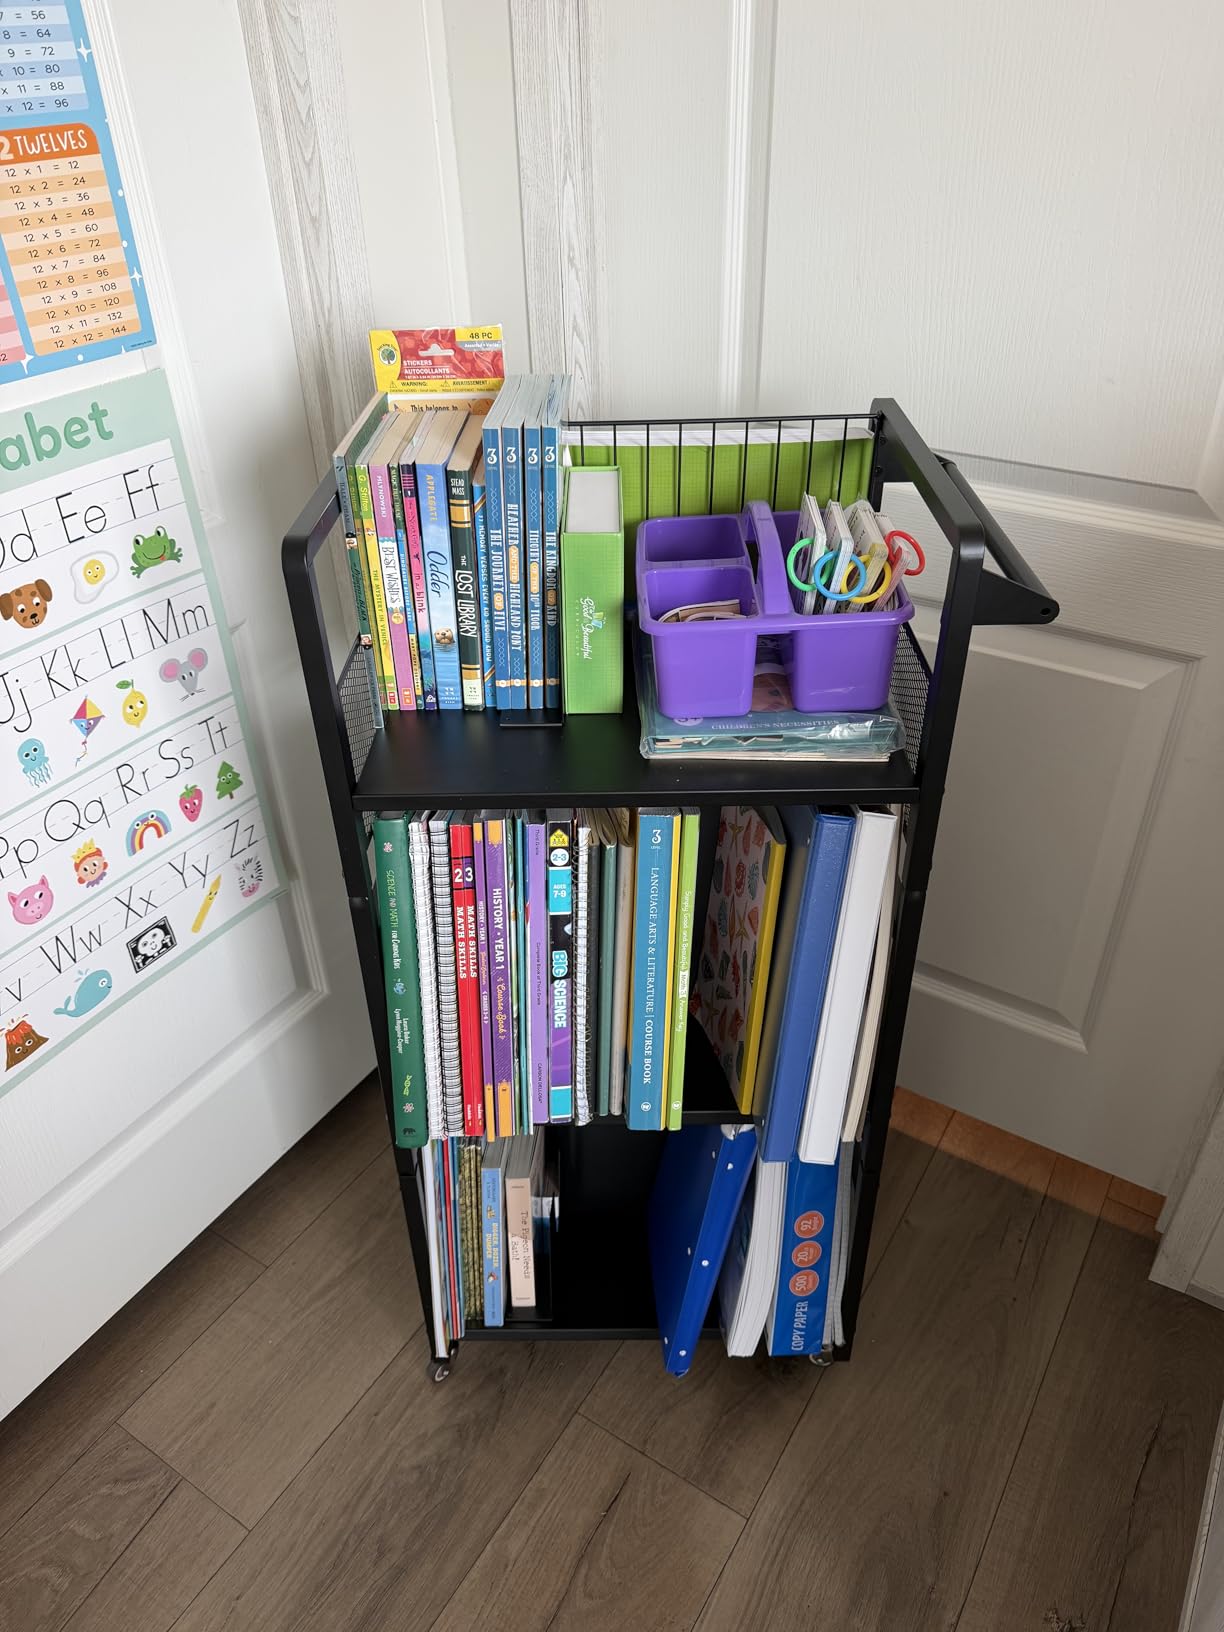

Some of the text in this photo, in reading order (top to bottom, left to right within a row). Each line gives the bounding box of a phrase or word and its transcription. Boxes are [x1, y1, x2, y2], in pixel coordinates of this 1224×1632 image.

[31, 10, 46, 20] 56
[3, 28, 51, 39] 8 64
[7, 47, 55, 58] 9 72
[13, 64, 60, 76] 10 80
[17, 82, 64, 93] 11 88
[22, 98, 69, 111] 12 96
[13, 129, 88, 156] TWELVES
[5, 161, 79, 177] 12 1 12
[10, 177, 86, 194] 12 2 24
[15, 192, 90, 210] 12 3 36
[19, 218, 30, 226] 12
[81, 208, 95, 216] 48
[24, 224, 98, 242] 12 5 60
[28, 239, 100, 258] 12 6 72
[33, 254, 106, 274] 12 7 84
[37, 269, 109, 289] 12 8 96
[42, 283, 117, 304] 12 9 108
[46, 297, 120, 319] 12 10 120
[50, 326, 60, 334] 12
[107, 312, 122, 321] 132
[54, 326, 127, 348] 12 12 144
[469, 332, 493, 340] 48 PC
[487, 448, 498, 465] 3
[506, 447, 517, 463] 3
[528, 448, 538, 464] 3
[545, 446, 556, 463] 3
[450, 478, 465, 487] STEAD
[451, 487, 465, 496] MASS
[56, 465, 160, 543] Ee Ff
[359, 475, 369, 512] G. Stilton
[376, 475, 387, 518] MLYNOWSKI
[426, 474, 438, 522] APPLEGATE
[507, 503, 519, 546] HEATHER
[479, 525, 487, 553] MEMORY
[490, 529, 501, 547] THE
[545, 531, 556, 547] THE
[381, 546, 402, 604] BEST WISHES
[400, 553, 408, 585] DINOSAURS
[427, 550, 450, 598] Odder
[491, 550, 504, 593] JOURNEY
[546, 550, 557, 590] KINGDOM
[455, 569, 474, 598] LOST
[375, 583, 383, 612] MYSTERY
[509, 583, 522, 628] HIGHLAND
[379, 614, 385, 622] IN
[457, 599, 478, 638] LIBRARY
[494, 611, 505, 632] FIVE
[547, 605, 557, 627] KIND
[380, 624, 388, 646] VENICE
[511, 630, 522, 652] PONY
[0, 598, 210, 733] Jj Kk Ll Mm
[43, 796, 111, 842] Qq
[115, 763, 151, 805] Rr
[158, 738, 195, 779] Ss
[198, 715, 229, 756] Tt
[651, 829, 662, 844] 3
[552, 854, 567, 862] 2-3
[386, 869, 396, 896] SCIENCE
[454, 868, 463, 883] 2
[464, 867, 474, 882] 3
[39, 924, 103, 974] Ww
[114, 886, 158, 930] Xx
[168, 852, 211, 889] Yy
[223, 819, 259, 858] Zz
[388, 897, 396, 908] AND
[553, 890, 567, 898] 7-9
[681, 890, 691, 912] Simply
[388, 908, 399, 928] MATH
[492, 888, 503, 929] HISTORY
[682, 913, 690, 929] Good
[456, 906, 467, 979] MATH SKILLS
[467, 905, 478, 978] MATH SKILLS
[494, 937, 504, 963] YEAR
[680, 943, 688, 971] Beautiful
[643, 867, 659, 1084] LANGUAGE ARTS & LITERATURE COURSE BOOK
[552, 950, 568, 1029] BIG SCIENCE
[496, 983, 508, 1034] Course Book
[675, 1021, 684, 1032] Key
[800, 1220, 812, 1231] 92
[511, 1240, 520, 1261] Bath!
[520, 1210, 531, 1280] The Pigeon Needs
[795, 1275, 808, 1291] 500
[791, 1301, 809, 1351] COPY PAPER
